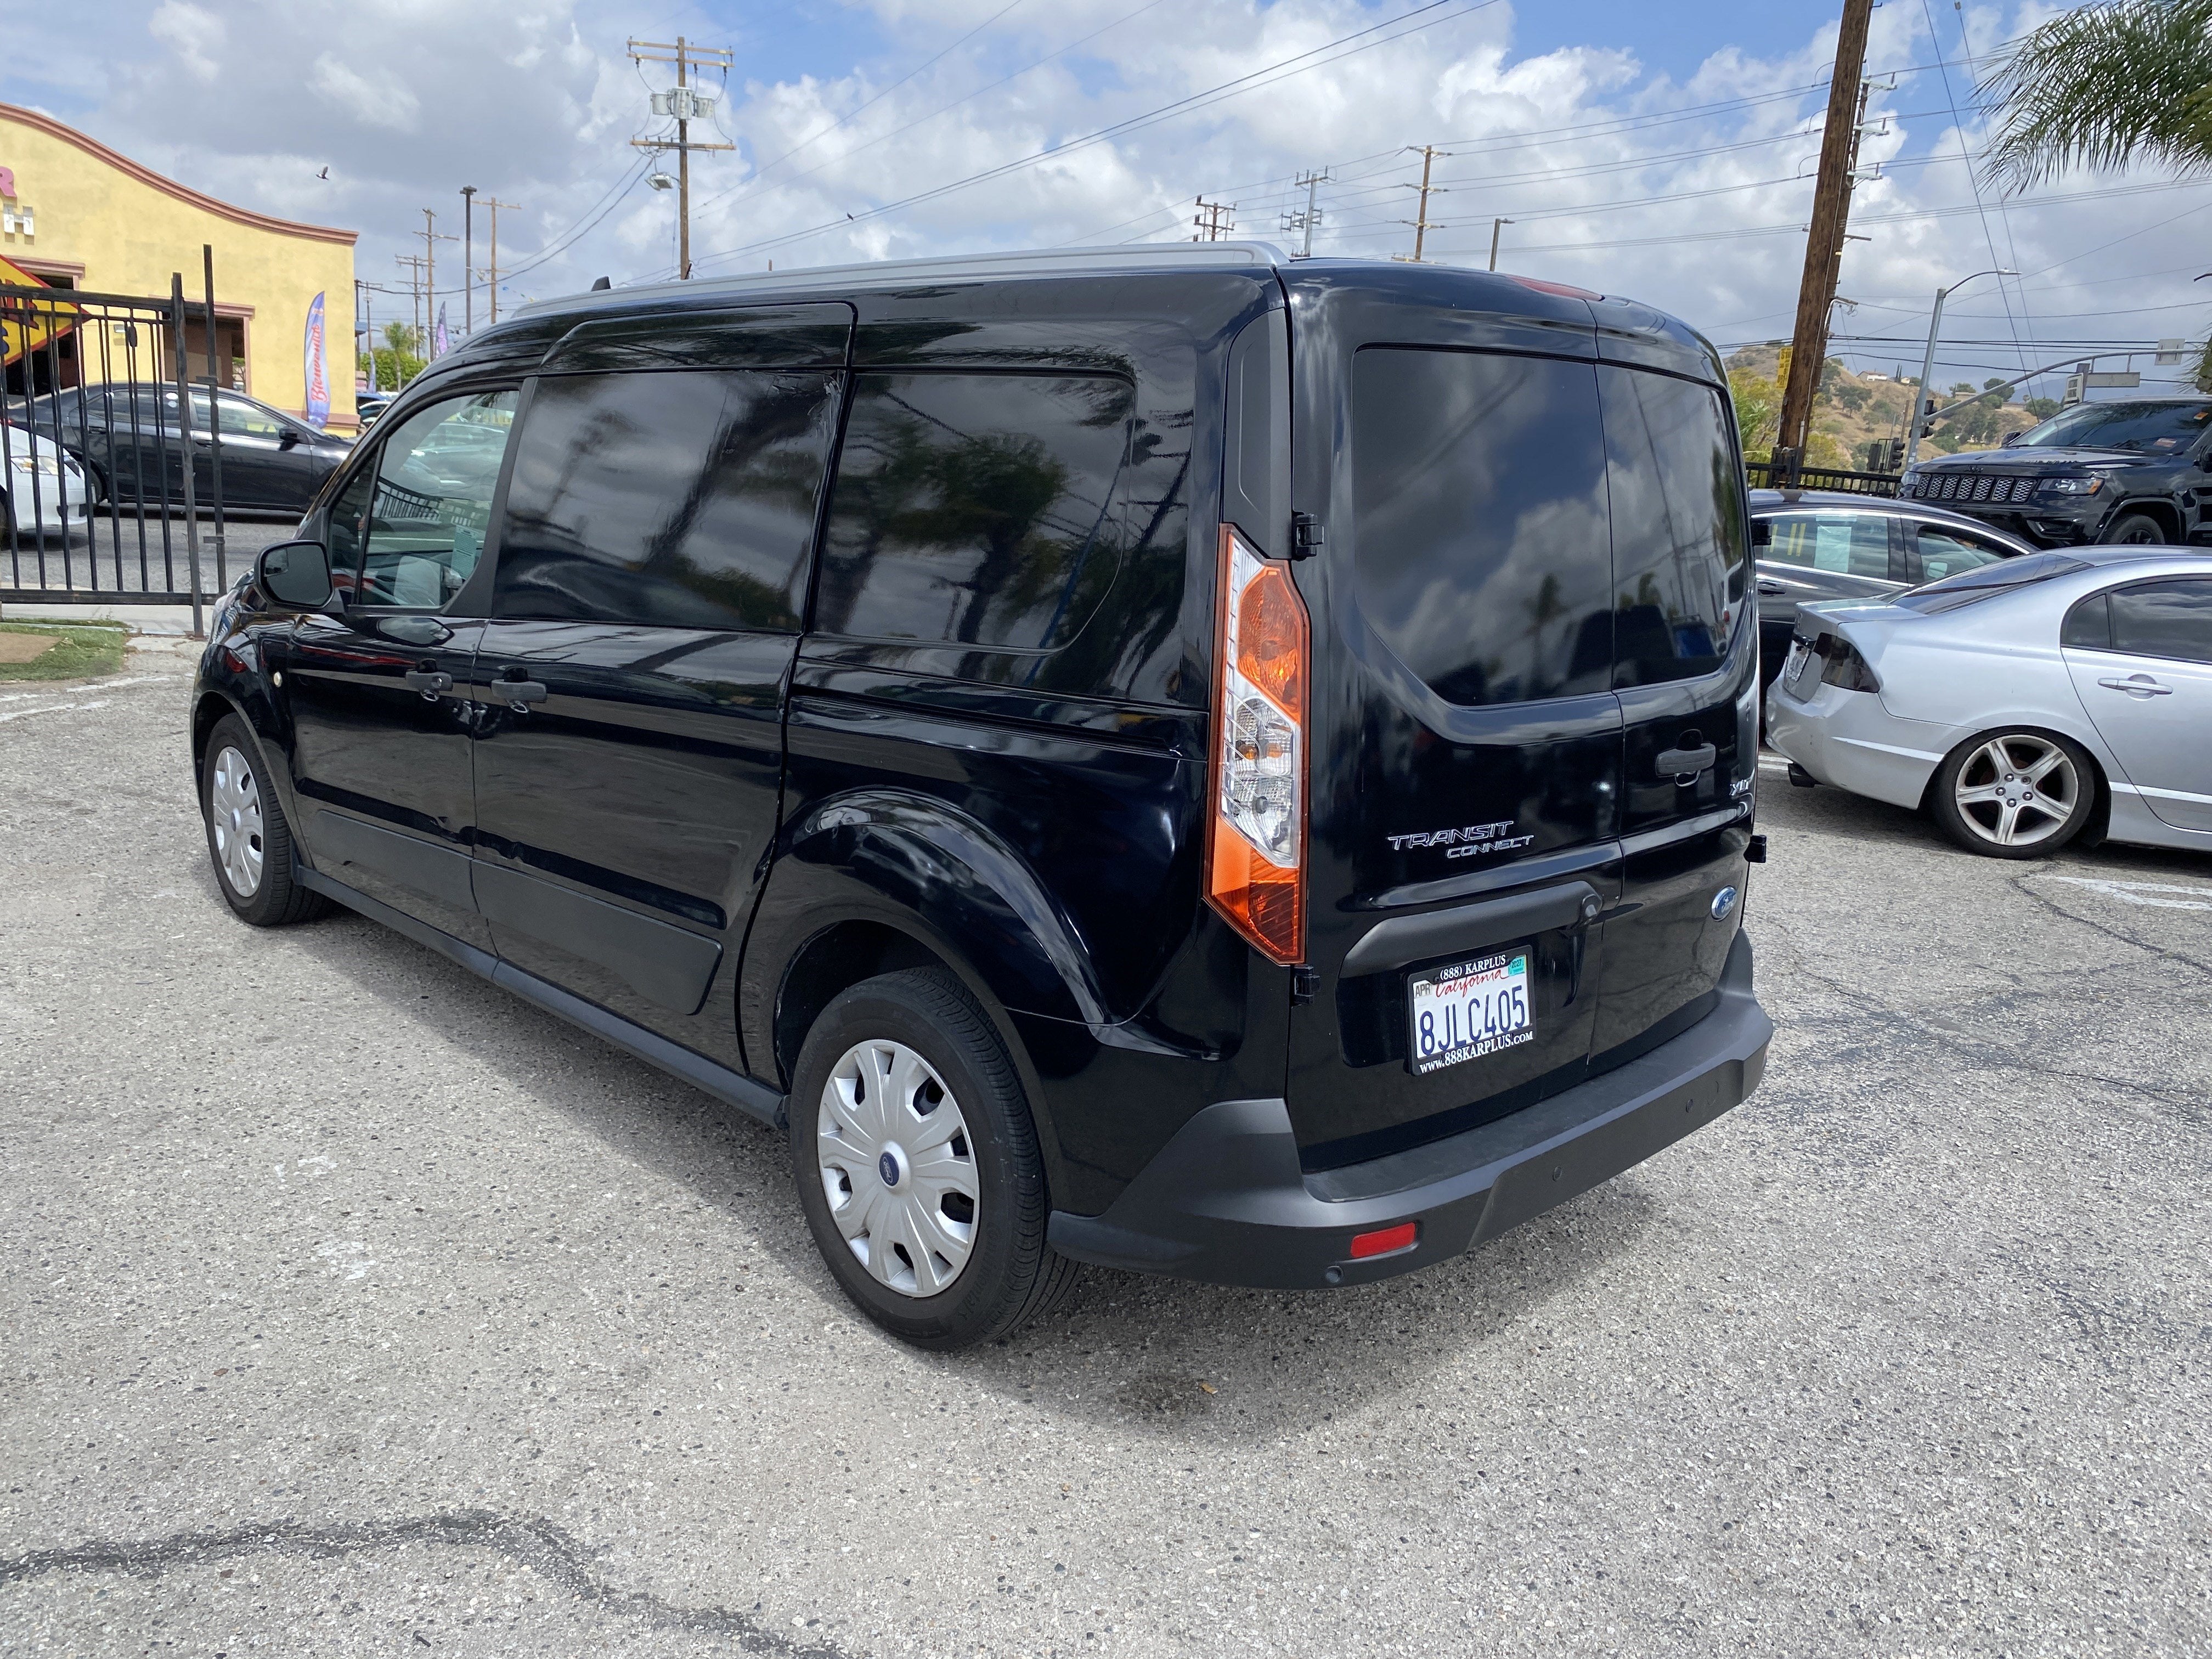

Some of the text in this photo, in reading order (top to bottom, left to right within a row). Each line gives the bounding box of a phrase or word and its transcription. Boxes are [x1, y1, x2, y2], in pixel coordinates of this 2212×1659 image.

[1387, 821, 1514, 850] TRANSIT
[1446, 835, 1534, 859] CONNECT
[1440, 954, 1506, 980] (888) KARPLUS
[1415, 983, 1431, 998] APR
[1435, 968, 1510, 998] California
[1420, 985, 1525, 1056] 8JLC405
